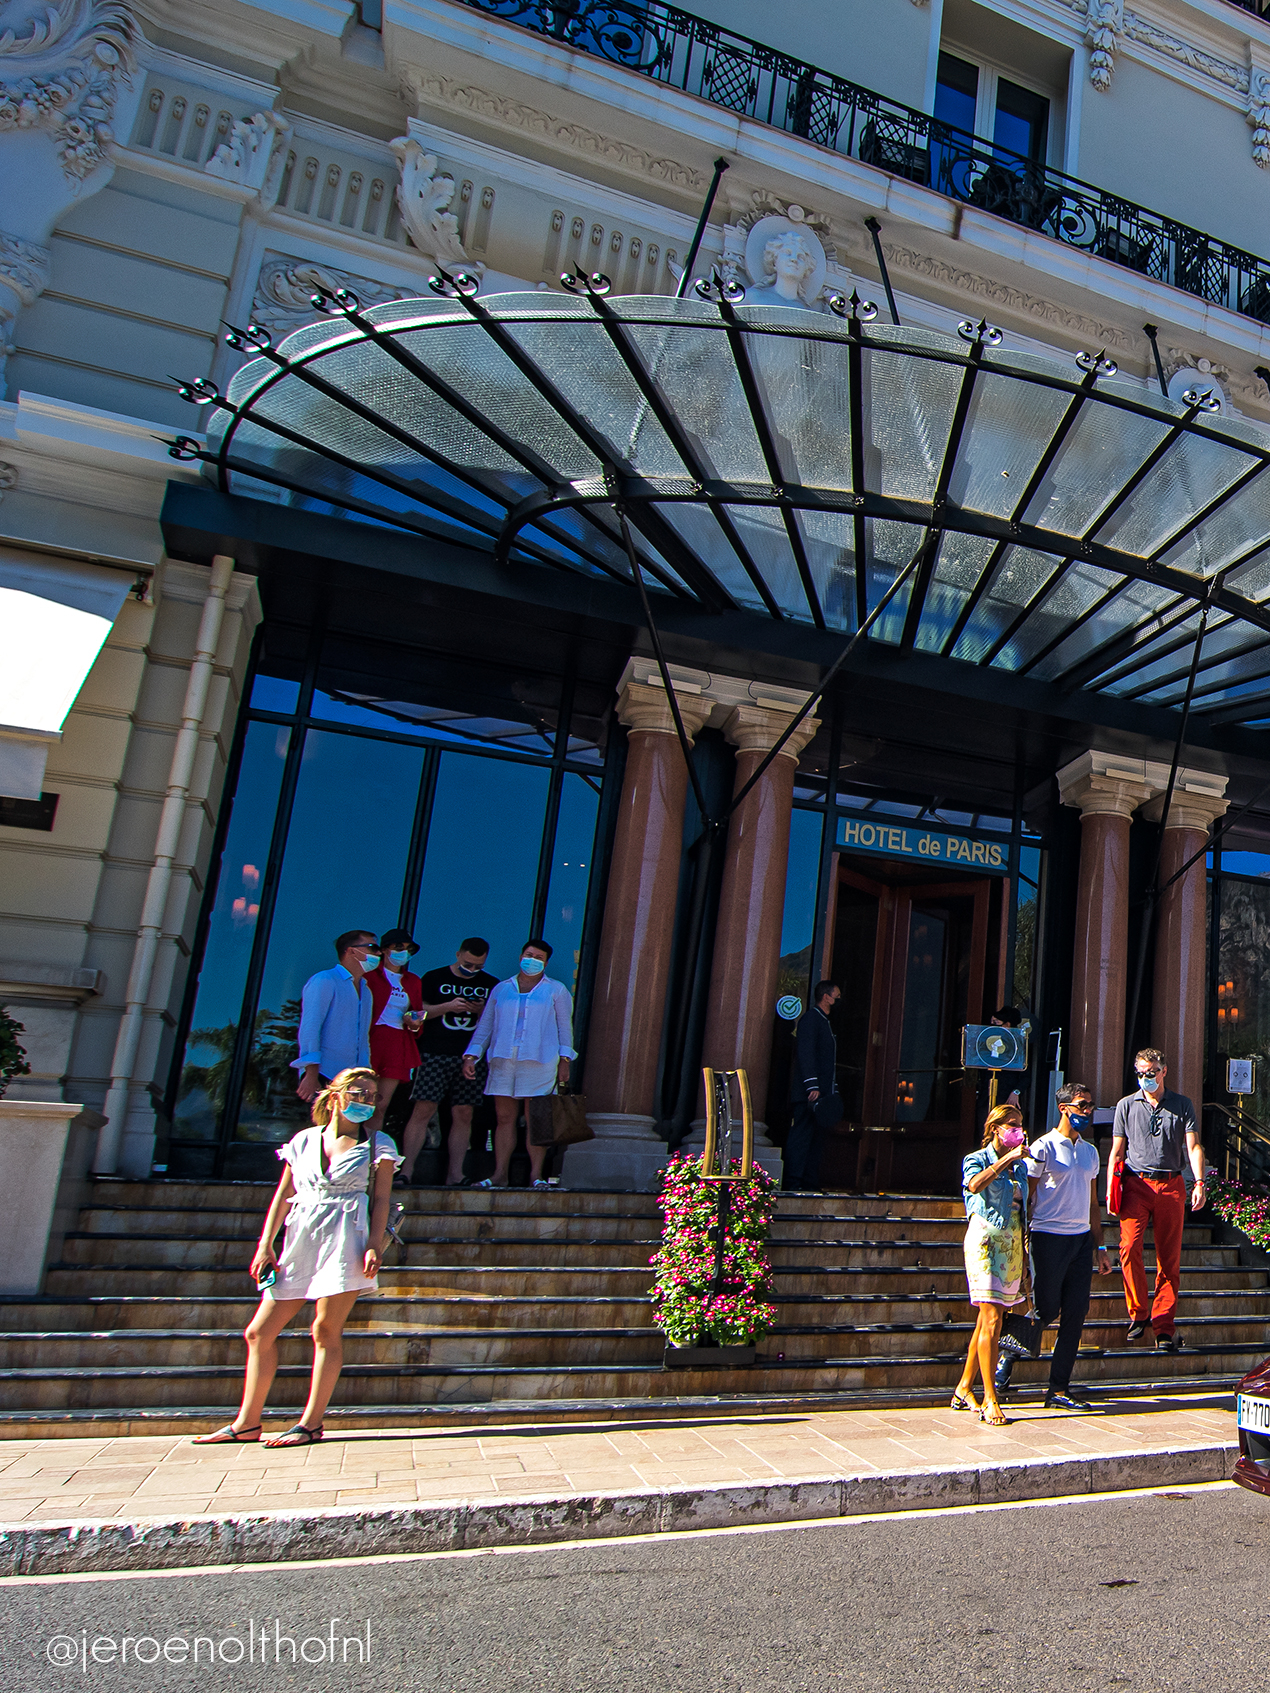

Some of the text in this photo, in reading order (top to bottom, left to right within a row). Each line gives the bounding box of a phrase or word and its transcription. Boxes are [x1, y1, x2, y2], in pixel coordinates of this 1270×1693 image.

[844, 821, 1002, 866] HOTEL de PARIS
[439, 983, 490, 999] GUCCI
